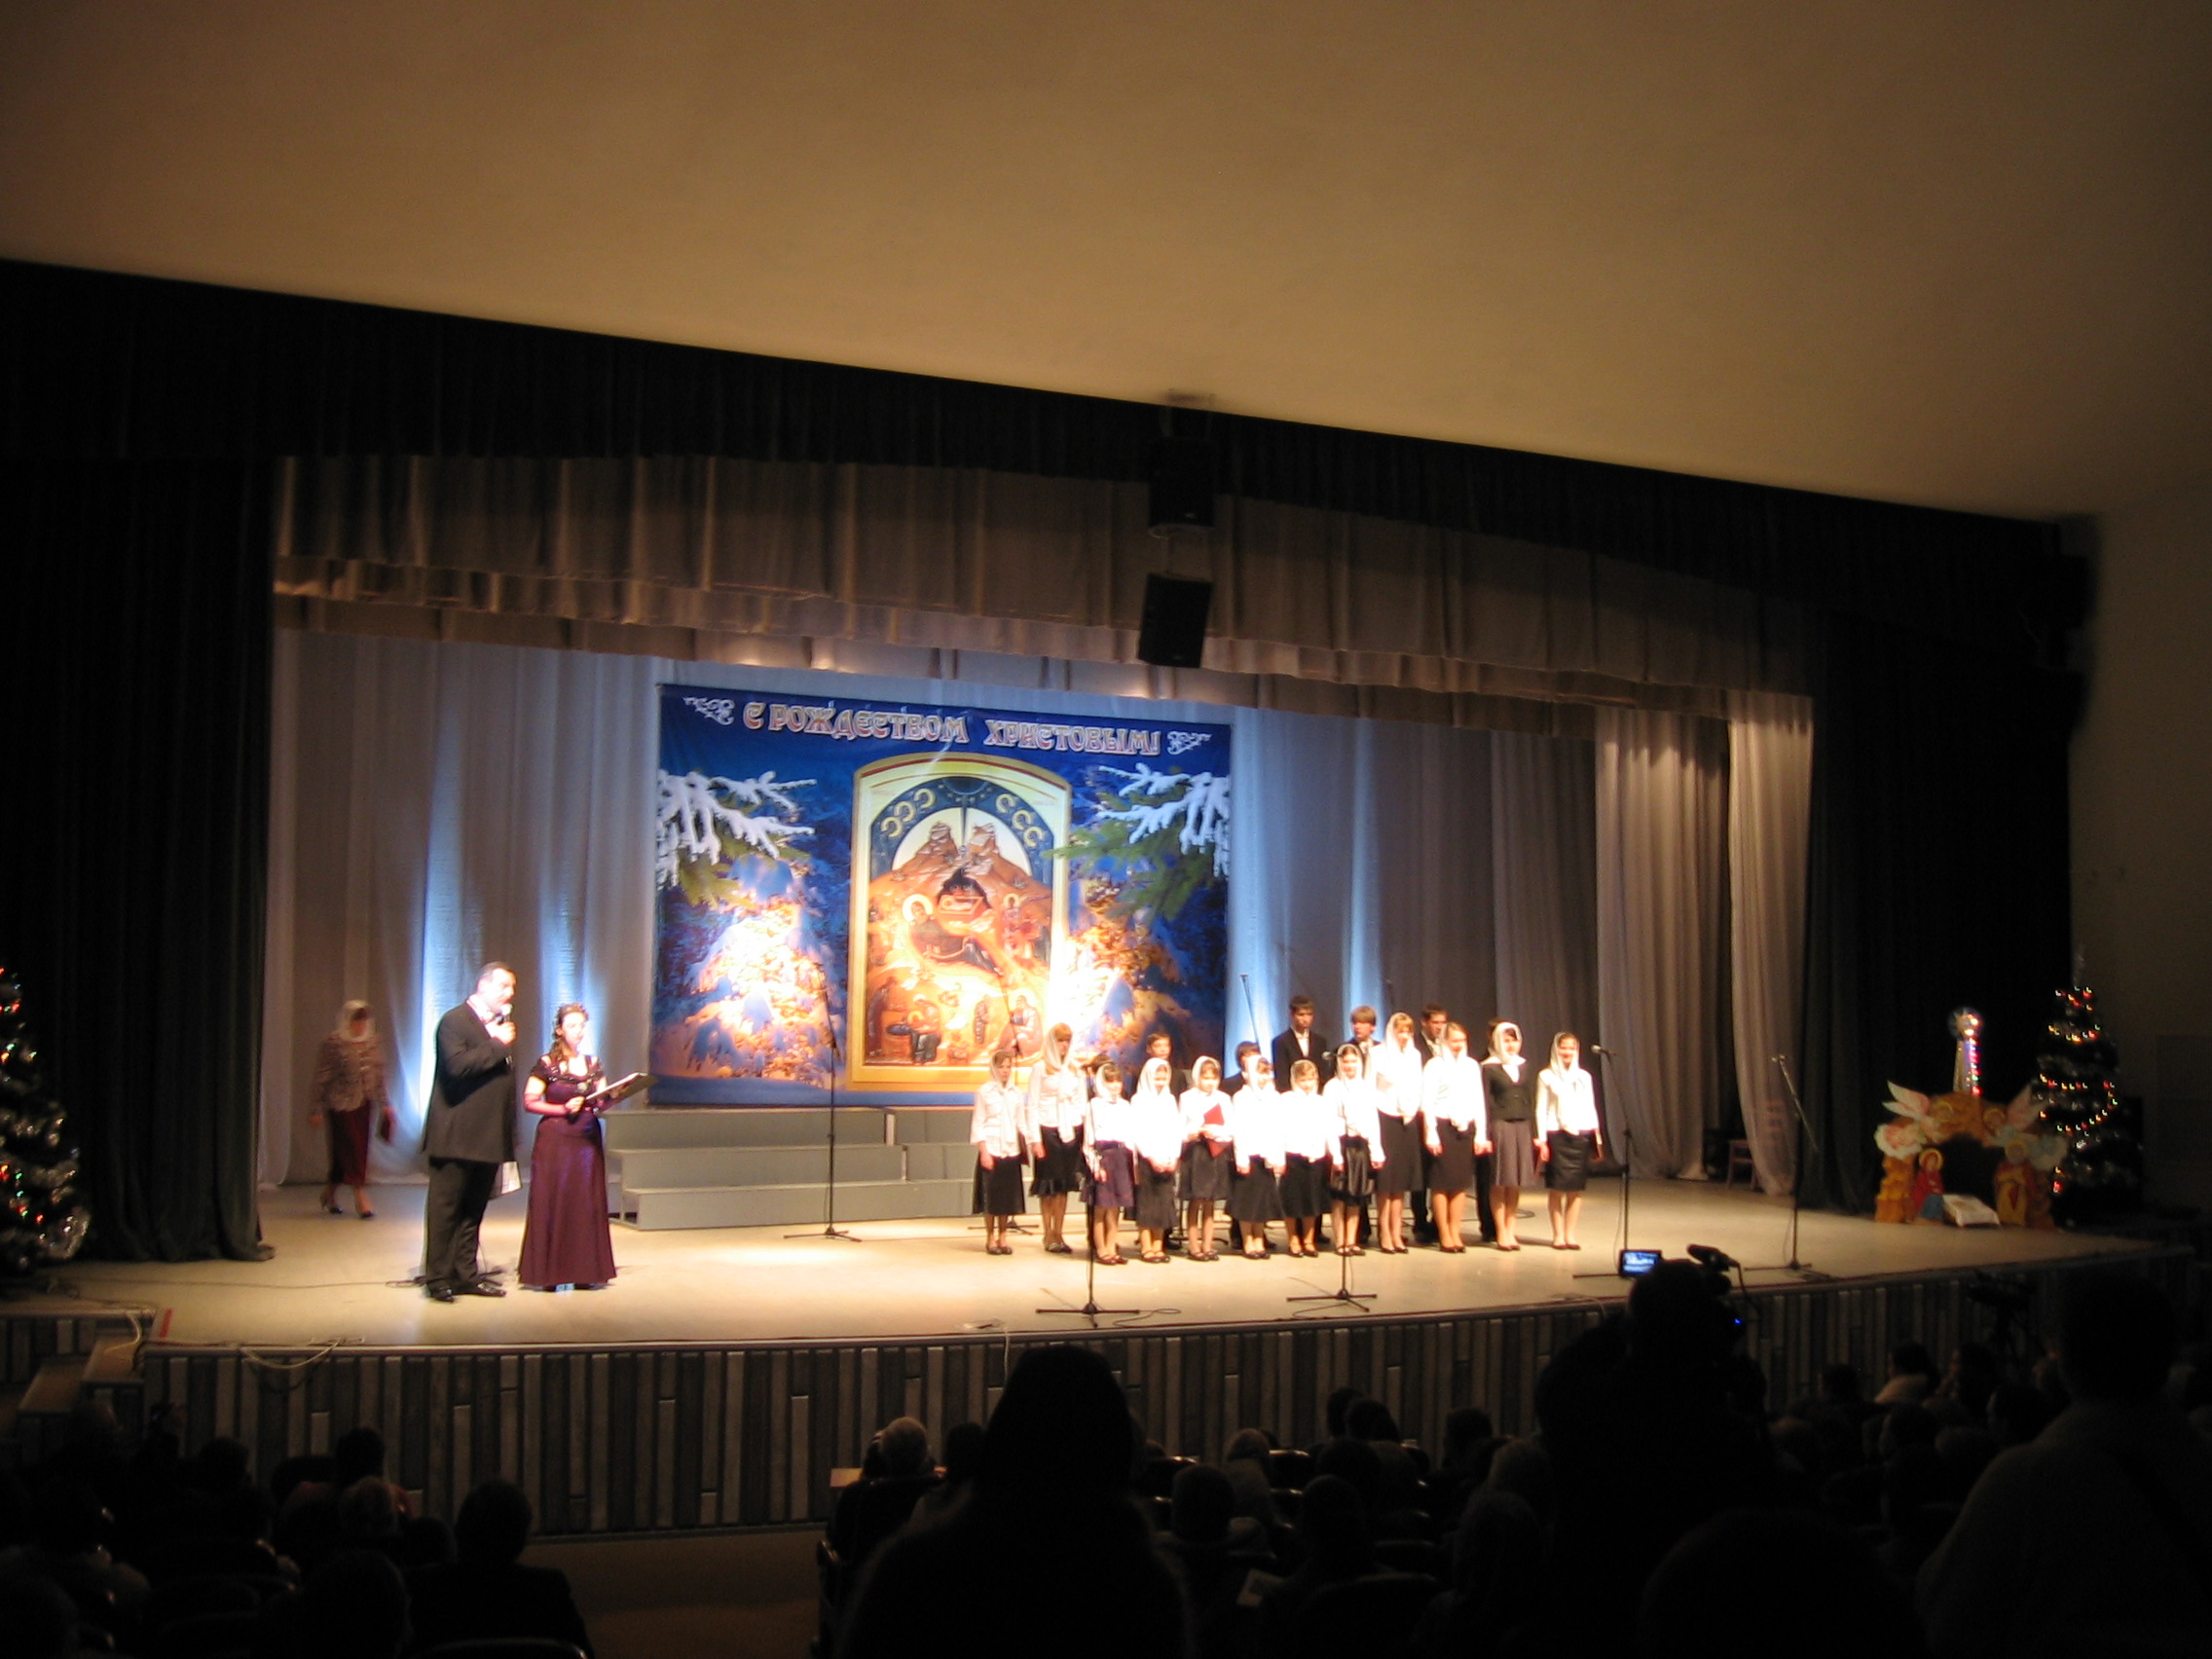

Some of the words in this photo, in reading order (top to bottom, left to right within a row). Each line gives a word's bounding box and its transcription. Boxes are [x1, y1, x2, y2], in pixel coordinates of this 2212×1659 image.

[743, 702, 766, 729] С
[768, 704, 970, 744] РОЖДЕСТВОМ
[983, 719, 1161, 756] ХРИСТОВЫМ!
